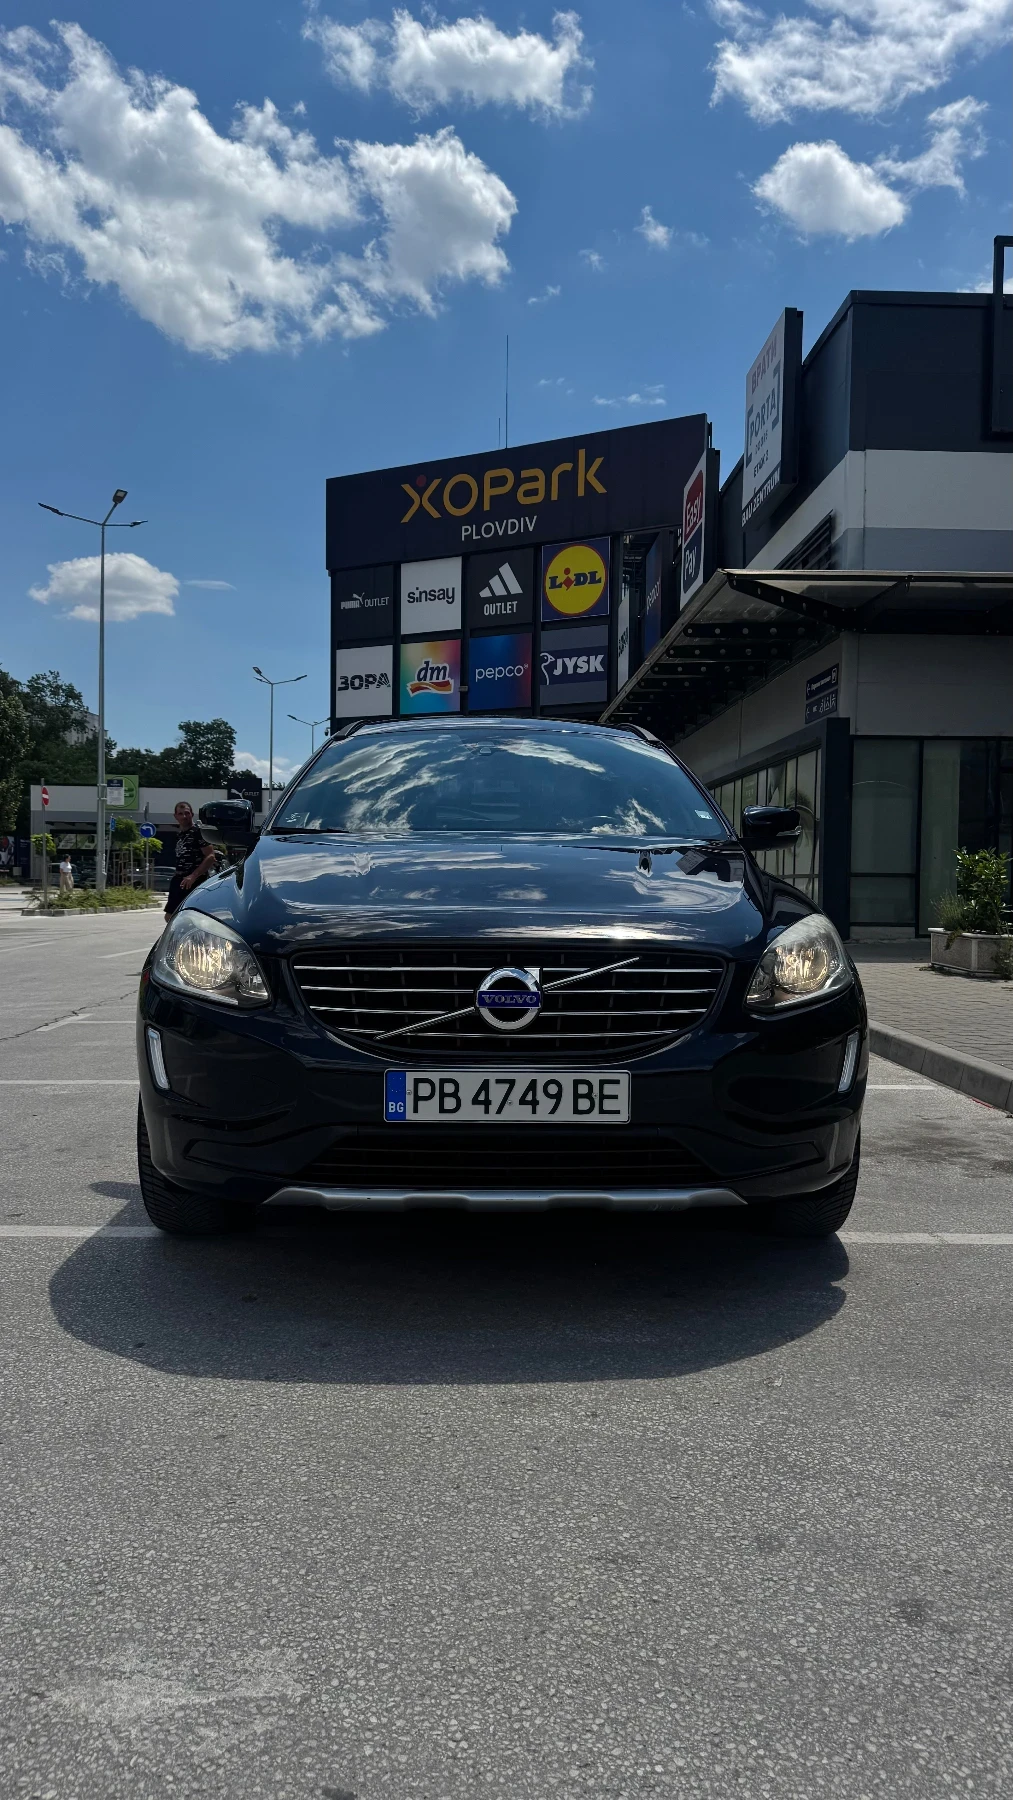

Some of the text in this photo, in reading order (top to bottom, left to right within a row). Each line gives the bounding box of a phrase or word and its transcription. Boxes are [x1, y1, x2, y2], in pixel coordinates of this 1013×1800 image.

[751, 335, 777, 395] ВРАТИ
[750, 388, 776, 447] PORTA
[686, 492, 702, 534] Easy
[461, 515, 537, 541] PLOVDIV
[684, 546, 697, 581] Pay
[340, 596, 390, 610] PUMA OUTLET
[407, 587, 456, 605] sinsay
[483, 601, 518, 616] OUTLET
[416, 661, 448, 682] dm
[553, 654, 605, 676] JYSK
[337, 672, 391, 692] ЗОРА
[481, 994, 537, 1004] VOLVO
[412, 1077, 621, 1115] PB 4749 BE
[388, 1101, 404, 1113] BG
